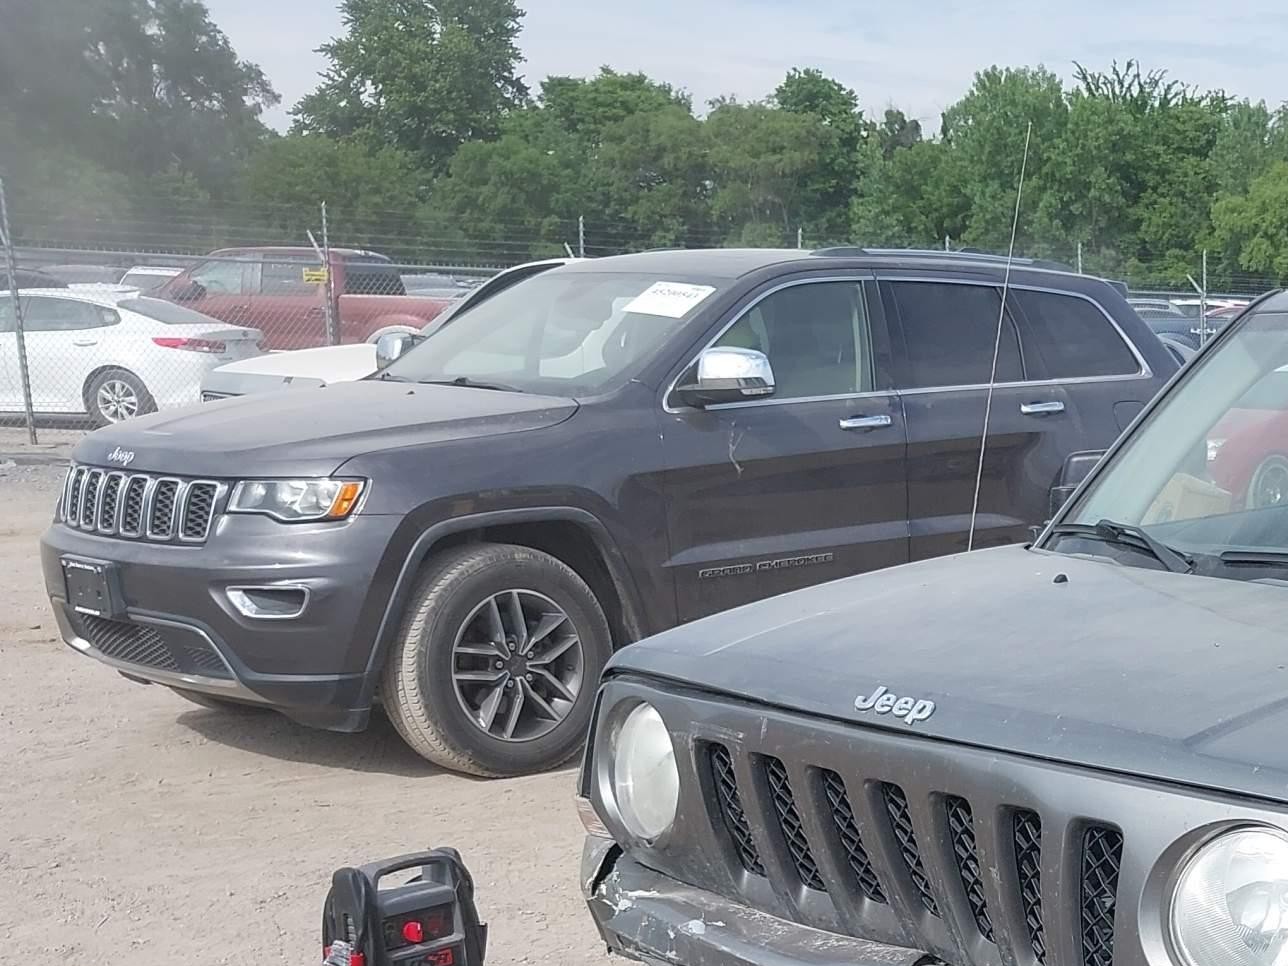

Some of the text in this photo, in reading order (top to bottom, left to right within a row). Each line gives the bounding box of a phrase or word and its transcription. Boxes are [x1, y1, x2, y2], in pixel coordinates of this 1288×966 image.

[107, 446, 135, 467] Jeep
[699, 552, 833, 578] GRAND CHEROKEE
[854, 685, 937, 726] Jeep
